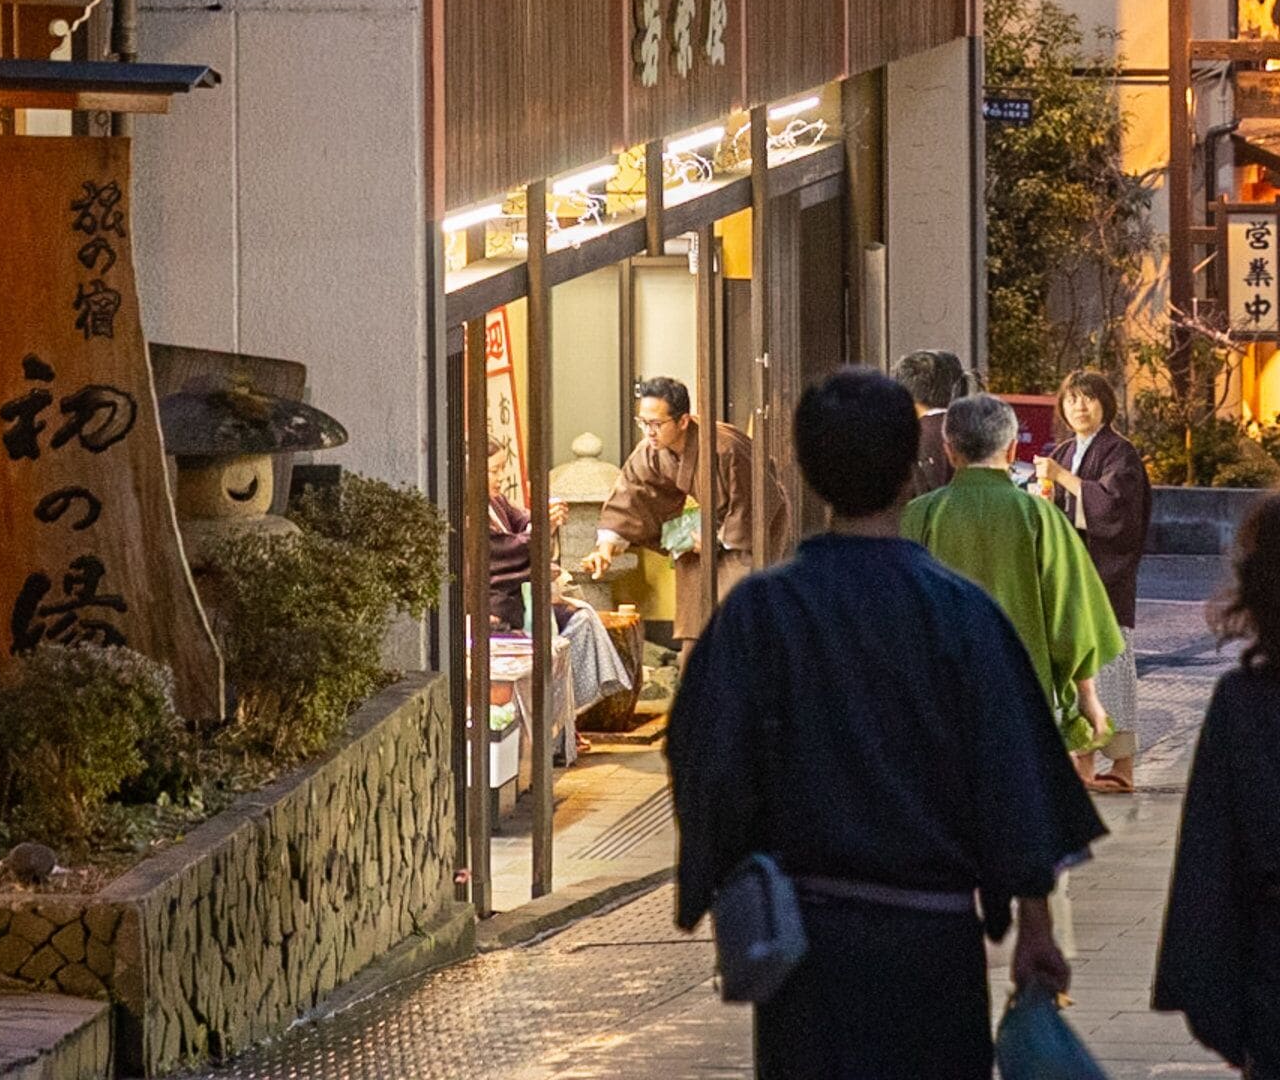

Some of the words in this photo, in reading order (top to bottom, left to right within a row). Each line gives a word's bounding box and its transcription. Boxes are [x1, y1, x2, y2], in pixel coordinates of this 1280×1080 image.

[71, 180, 127, 341] 旅の宿
[1243, 220, 1275, 323] 営業中
[0, 354, 137, 655] 初の湯
